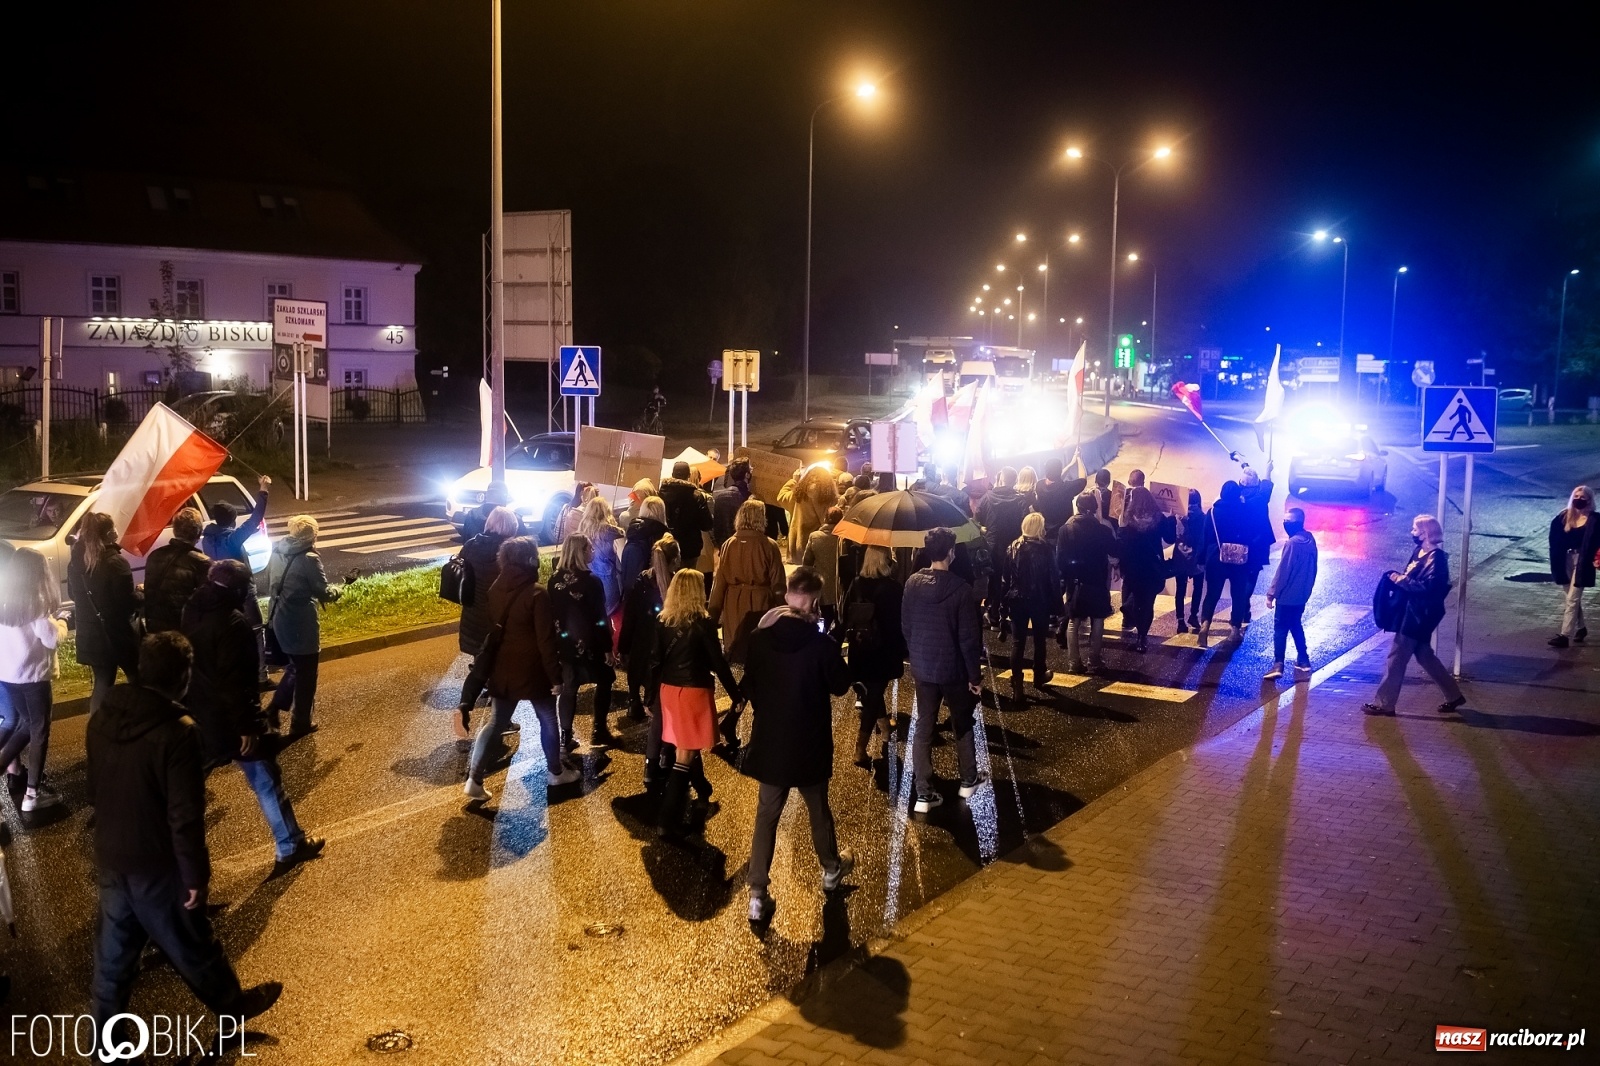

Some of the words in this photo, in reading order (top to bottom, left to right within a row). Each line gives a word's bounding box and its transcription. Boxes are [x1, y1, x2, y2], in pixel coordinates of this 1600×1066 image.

[277, 305, 295, 313] ZAKŁAD
[297, 306, 325, 316] SZKLARSKI
[87, 323, 176, 344] ZAJAZD
[208, 326, 270, 342] BISKU
[386, 330, 404, 345] 45
